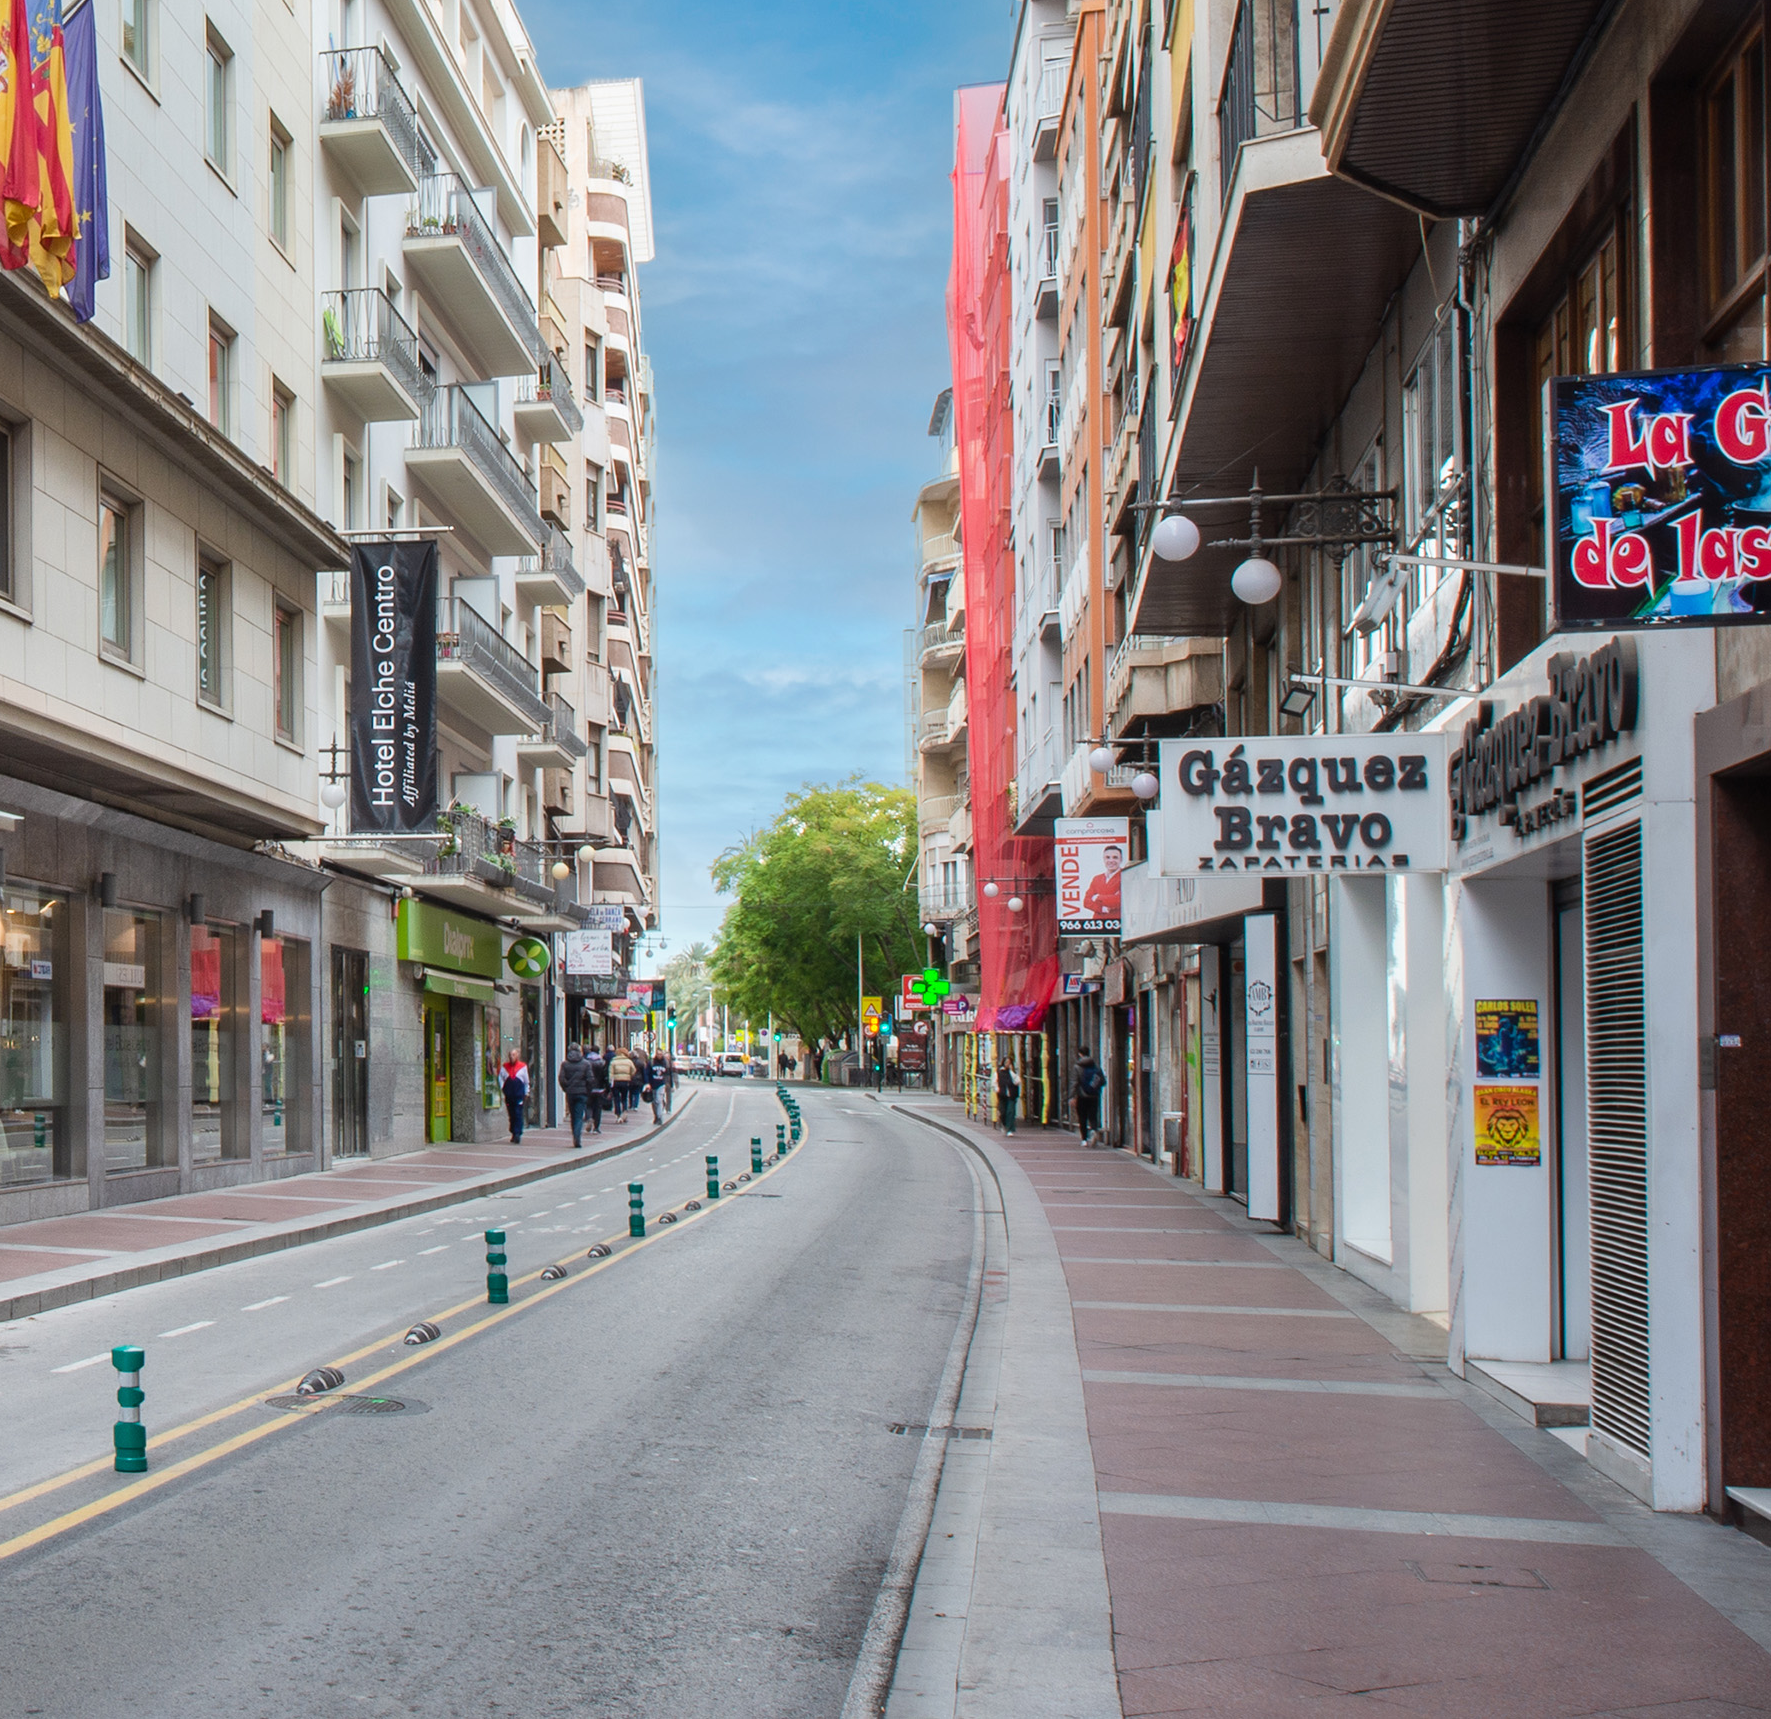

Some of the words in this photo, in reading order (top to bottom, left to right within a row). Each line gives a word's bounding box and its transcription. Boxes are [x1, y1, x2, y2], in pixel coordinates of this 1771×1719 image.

[1597, 397, 1696, 482] La
[1570, 517, 1656, 600] de
[372, 565, 395, 653] Centro
[371, 660, 395, 730] Elche
[402, 681, 416, 721] Meliá
[403, 722, 419, 739] by
[370, 739, 395, 806] Hotel
[402, 738, 419, 808] Affiliated
[1178, 744, 1429, 806] Gázquez
[1213, 805, 1393, 851] Bravo
[1060, 845, 1081, 918] VENDE
[1198, 854, 1410, 870] ZAPATERIAS
[1059, 920, 1082, 931] 966
[1083, 919, 1103, 930] 613
